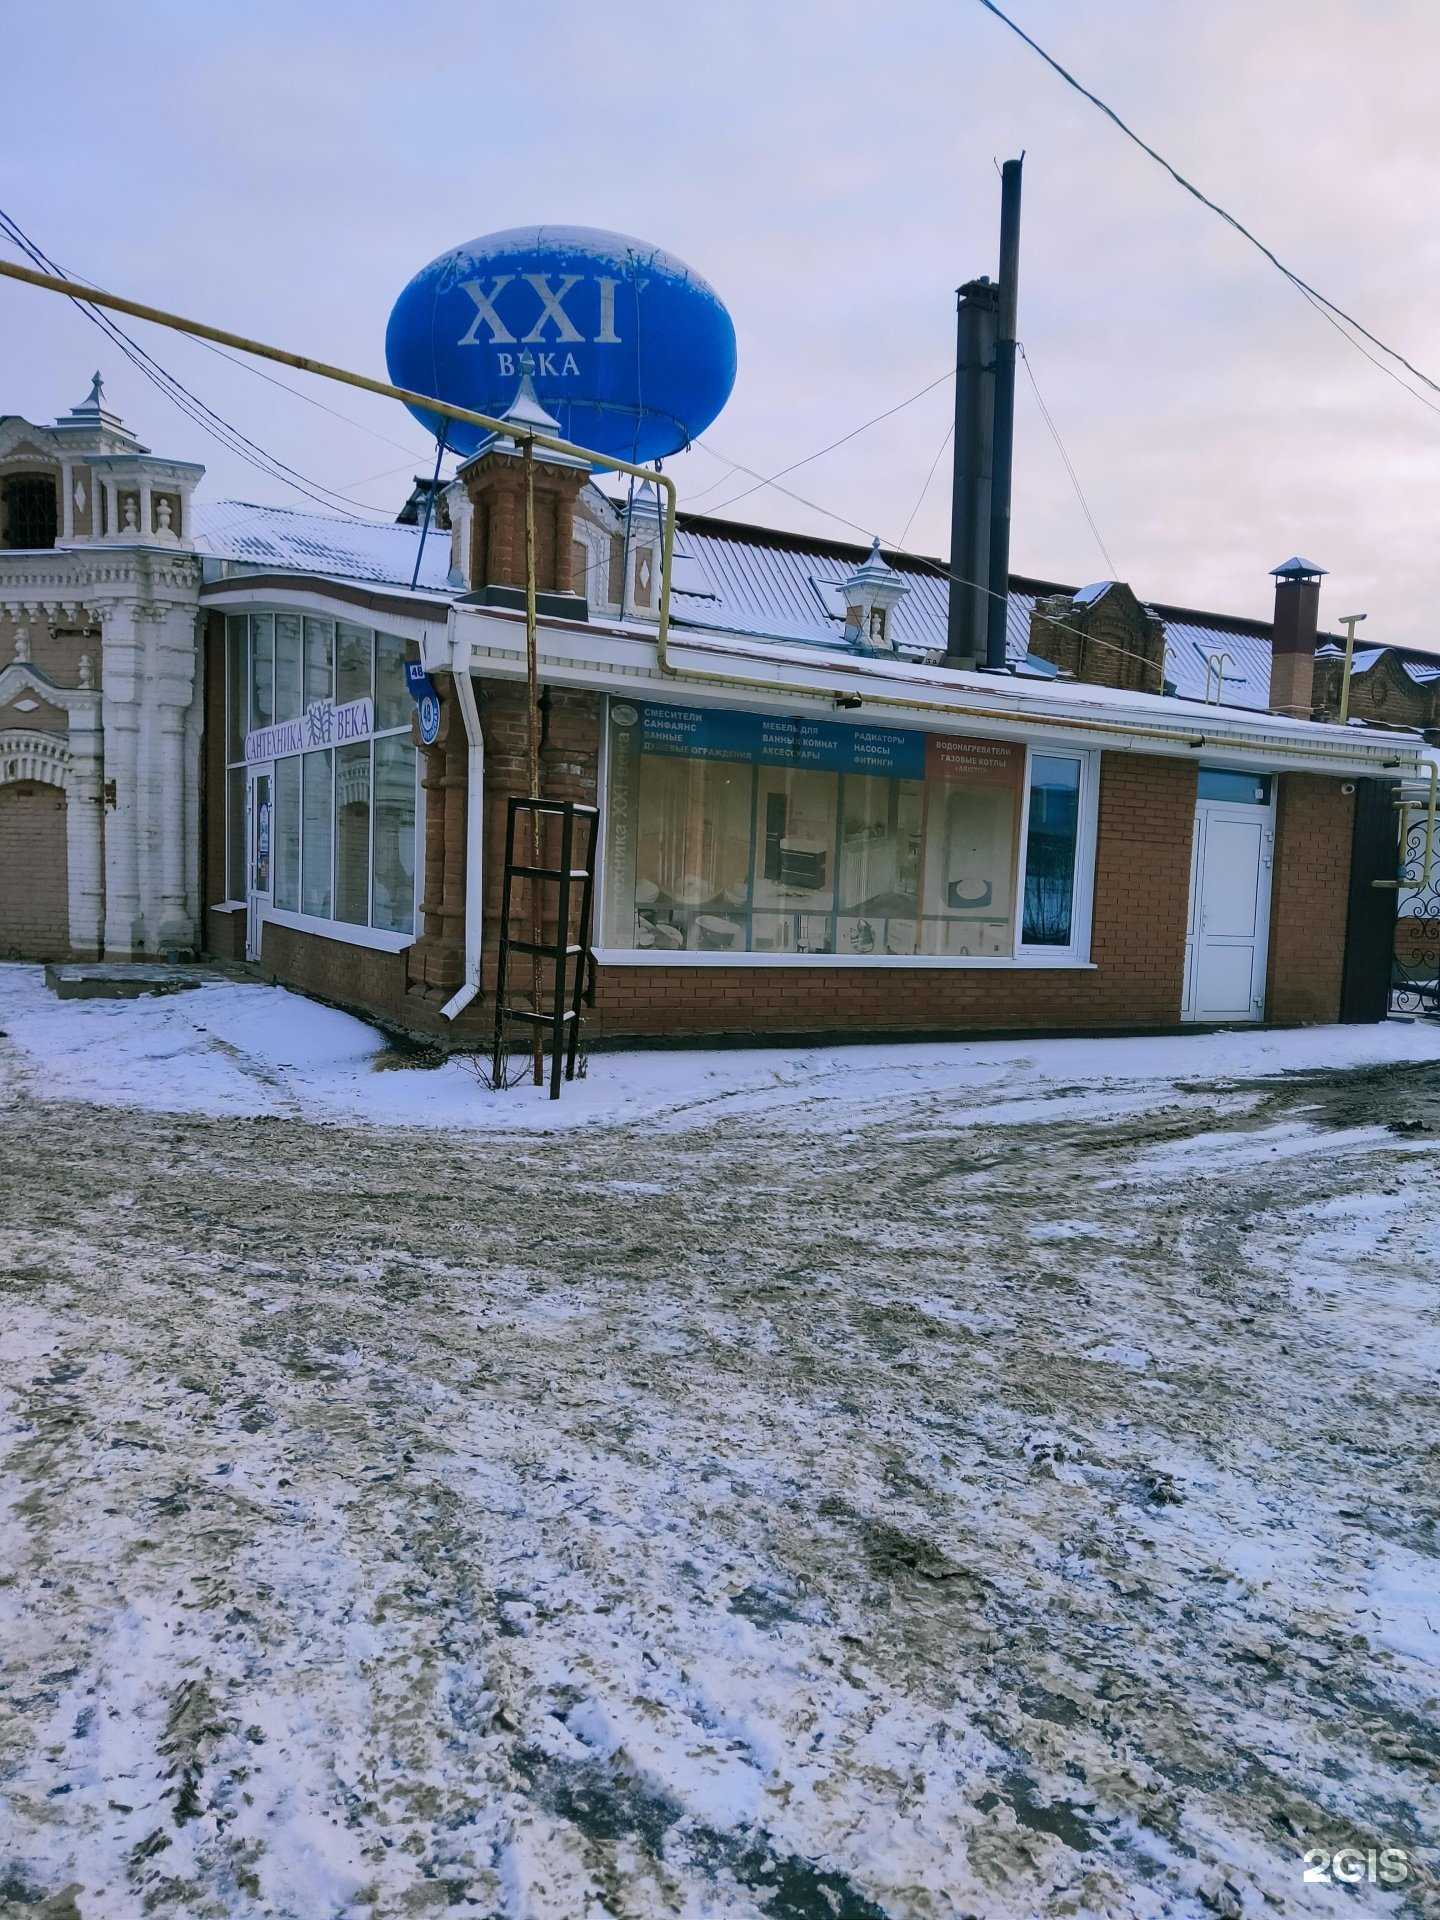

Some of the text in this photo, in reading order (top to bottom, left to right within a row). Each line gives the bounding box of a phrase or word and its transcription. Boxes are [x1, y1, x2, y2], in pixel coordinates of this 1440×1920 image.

[457, 273, 622, 346] XXI
[411, 666, 424, 678] 48
[644, 708, 703, 721] СМЕСИТЕЛИ
[246, 724, 303, 760] САНТЕХНИКА
[337, 704, 370, 740] ВЕКА
[644, 719, 697, 732] САНФАЯНС
[763, 721, 818, 736] МЕБЕЛЬ ДЛЯ
[763, 734, 838, 750] ВАННЫ КОМНАТ
[854, 732, 905, 744] РАДИАТОРЫ
[854, 744, 890, 755] НАСОСЫ
[936, 740, 1012, 756] ВОДОНАГРЕВАТЕЛИ
[940, 754, 1006, 769] ГАЗОВЫЕ КОТЛЫ
